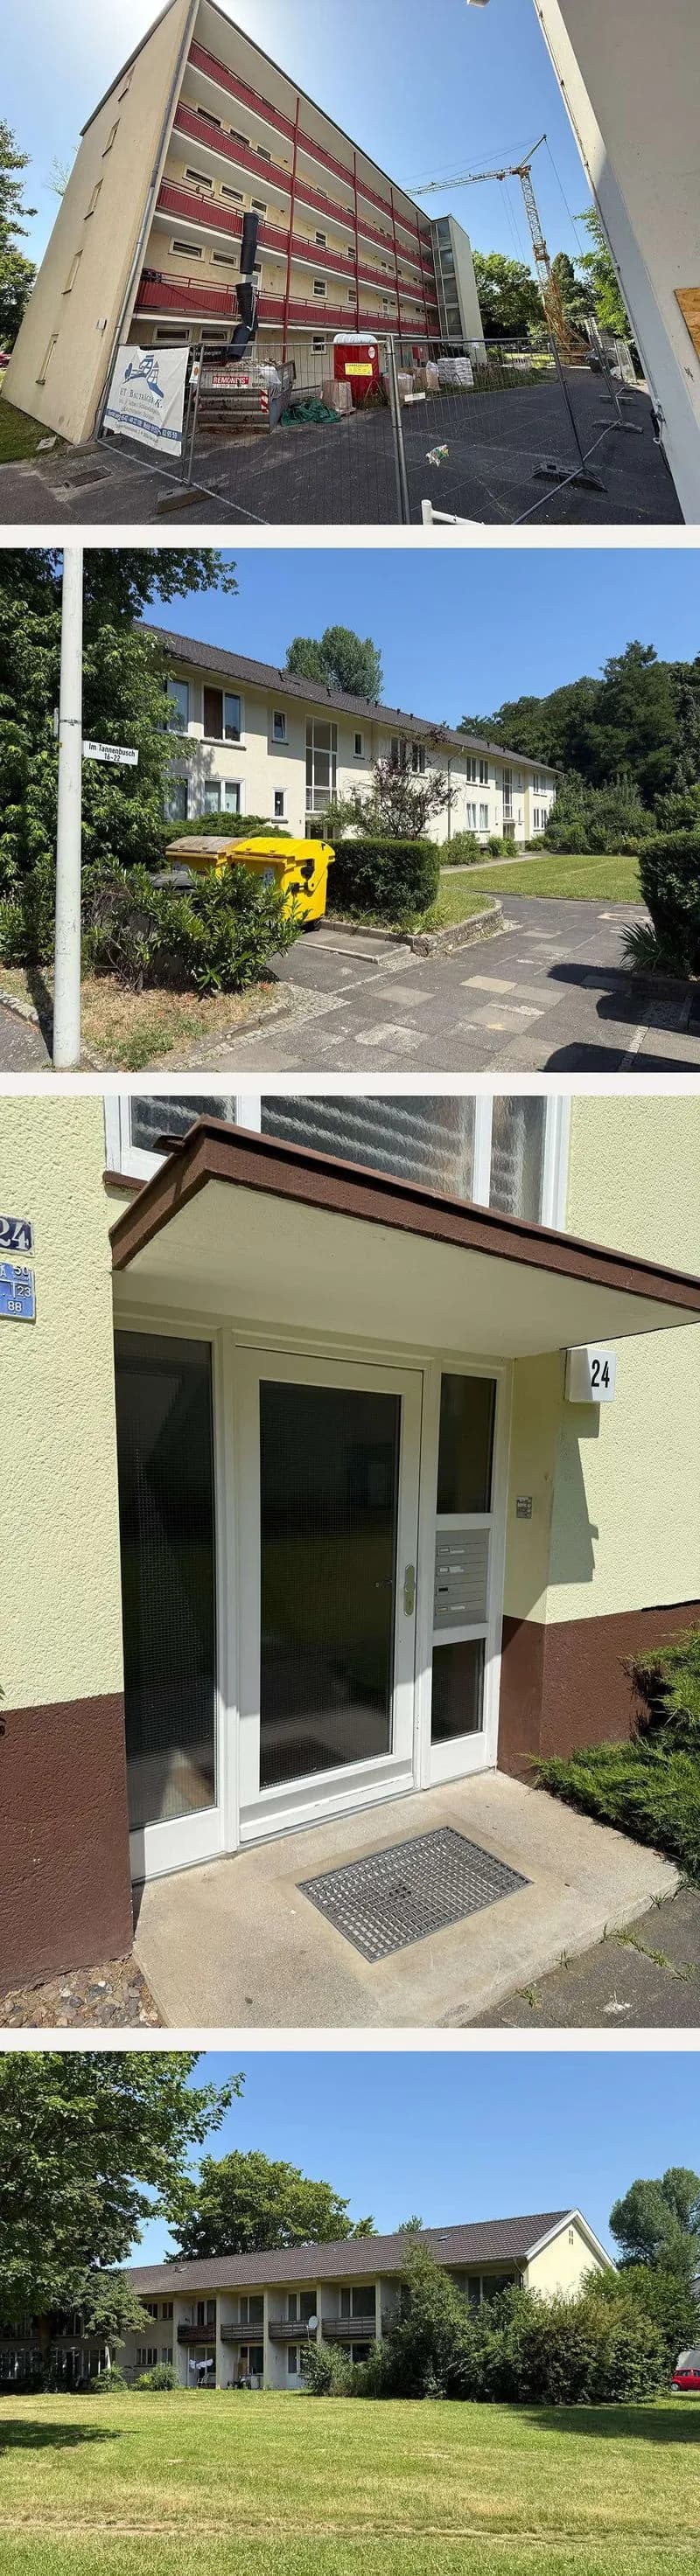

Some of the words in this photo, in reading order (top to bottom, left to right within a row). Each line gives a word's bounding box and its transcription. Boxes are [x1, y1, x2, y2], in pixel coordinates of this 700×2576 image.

[99, 744, 136, 756] Tannenbusch
[104, 752, 121, 762] 16-22
[0, 1216, 29, 1250] 24
[17, 1285, 32, 1298] 23
[8, 1300, 22, 1312] 88
[592, 1359, 610, 1388] 24
